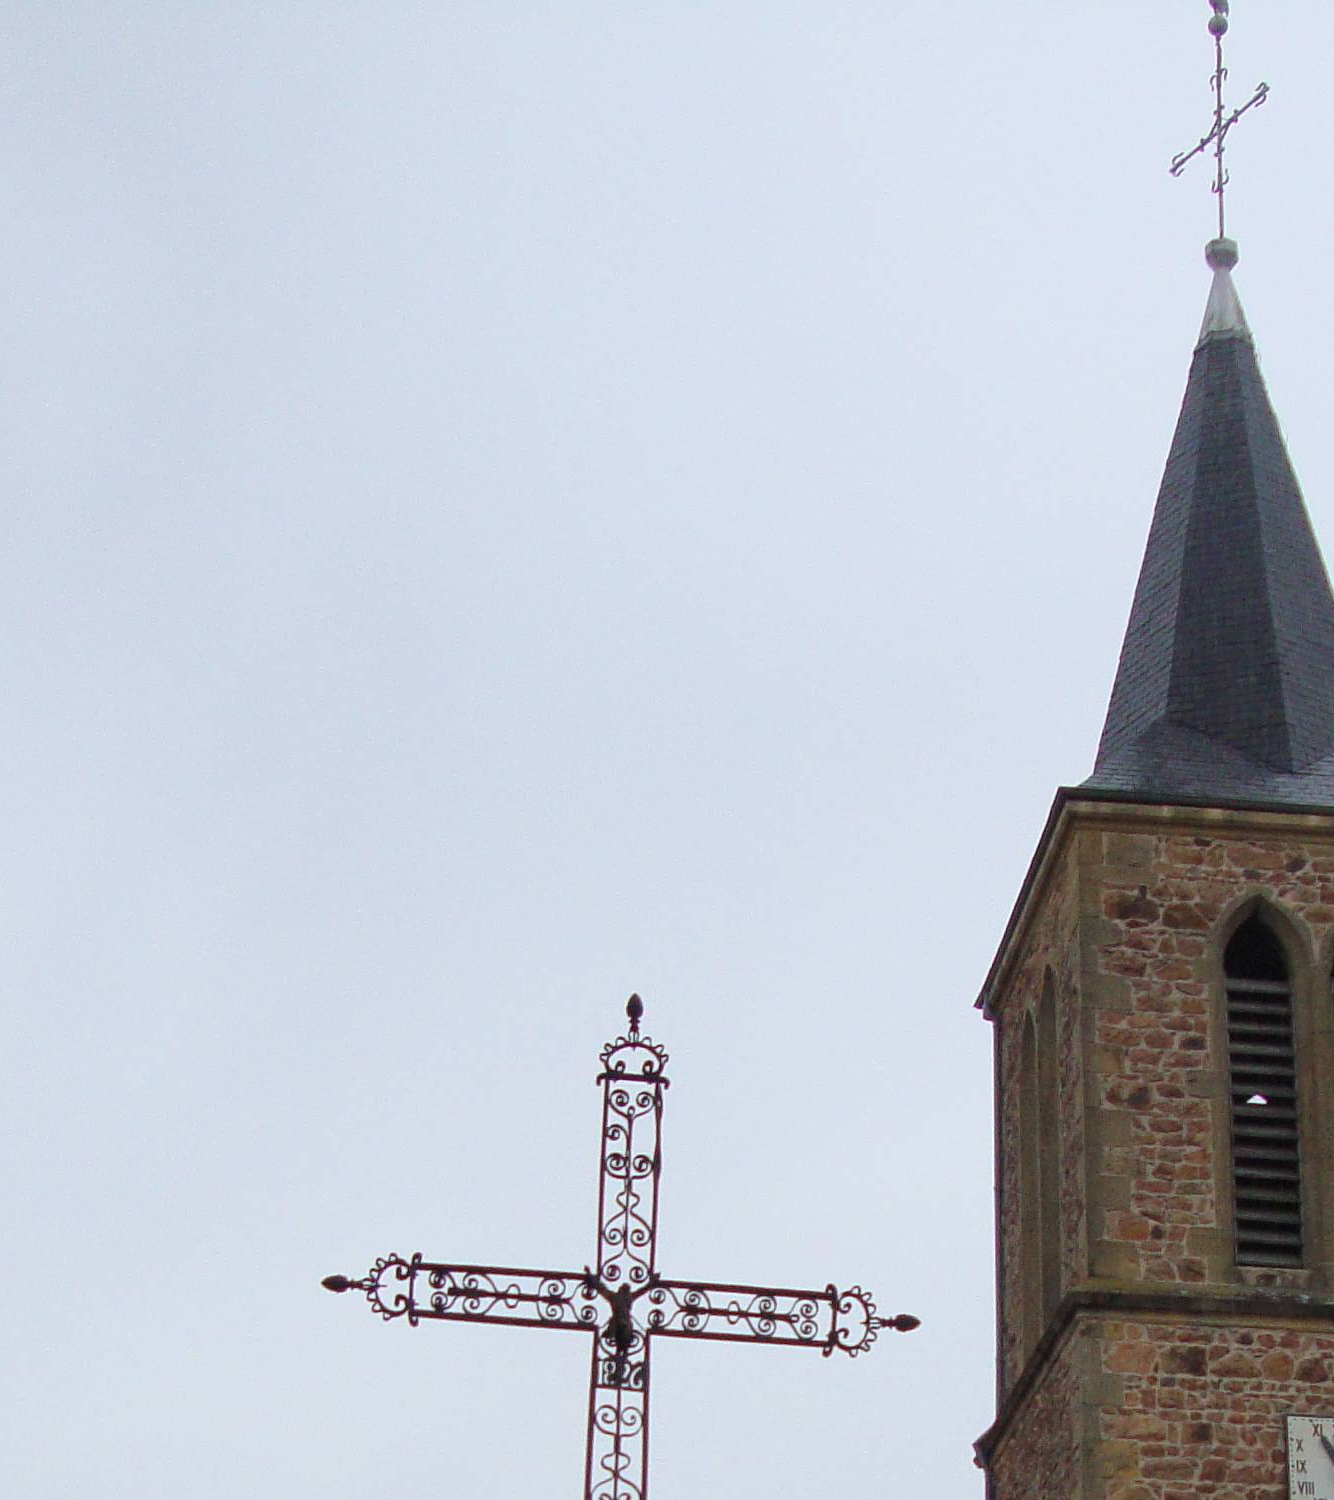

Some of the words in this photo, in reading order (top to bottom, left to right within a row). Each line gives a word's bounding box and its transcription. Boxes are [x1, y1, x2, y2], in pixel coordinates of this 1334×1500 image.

[1296, 1439, 1304, 1452] X
[1296, 1460, 1307, 1473] IX
[1297, 1481, 1315, 1495] VIII
